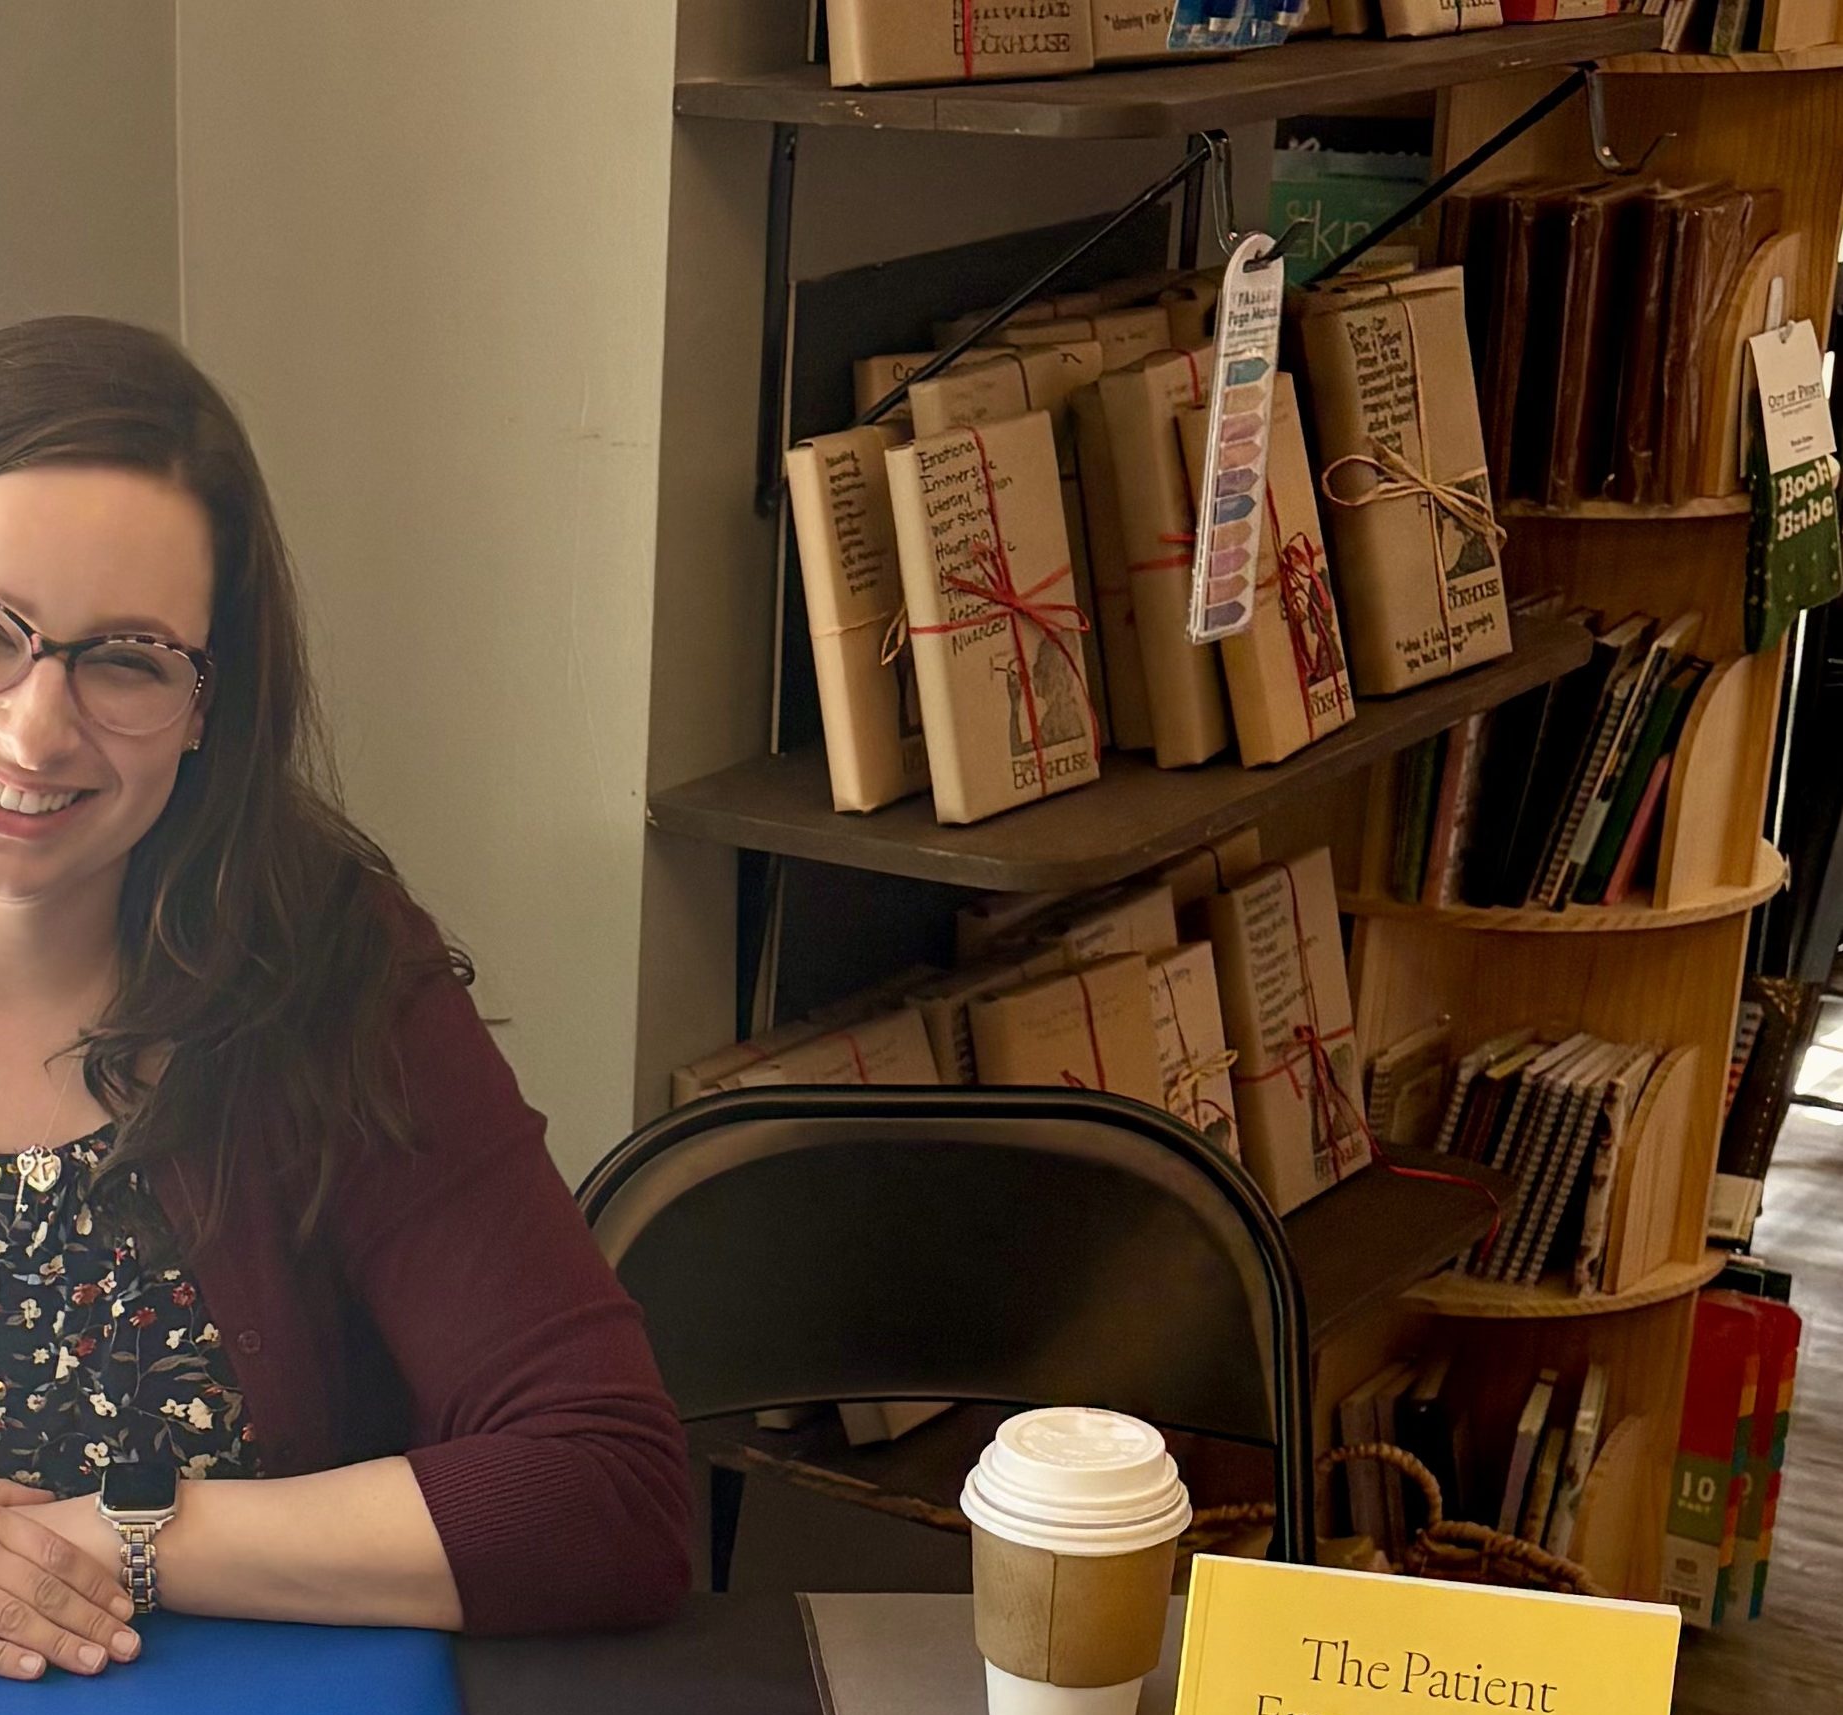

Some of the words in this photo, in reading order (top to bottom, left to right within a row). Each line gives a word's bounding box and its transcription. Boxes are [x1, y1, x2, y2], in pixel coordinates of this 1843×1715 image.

[918, 441, 976, 471] Emotiona
[1779, 460, 1830, 507] Book
[1681, 1471, 1716, 1502] 10
[1301, 1635, 1391, 1692] The
[1399, 1650, 1558, 1715] Patient
